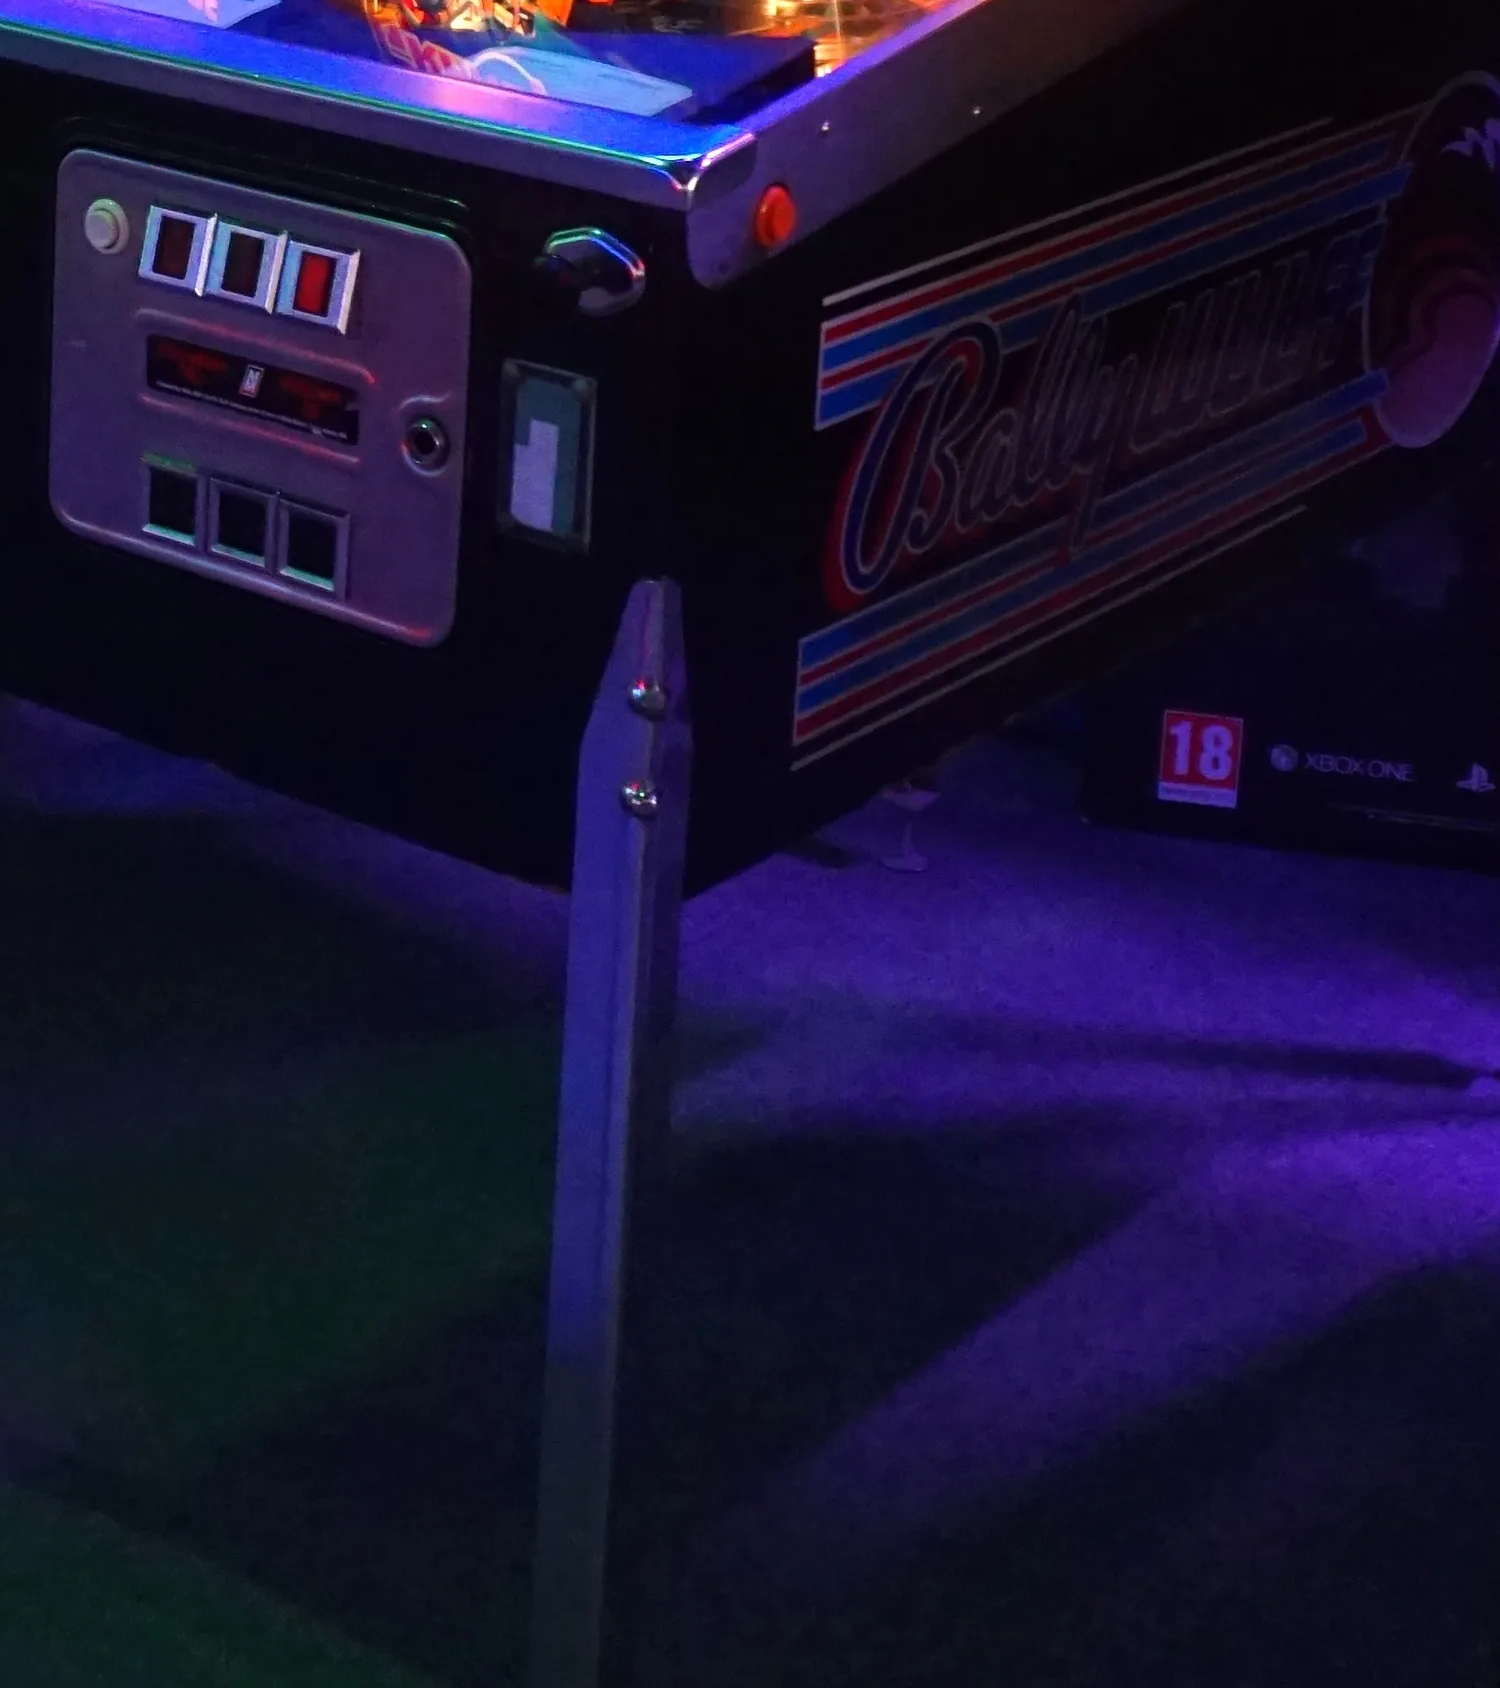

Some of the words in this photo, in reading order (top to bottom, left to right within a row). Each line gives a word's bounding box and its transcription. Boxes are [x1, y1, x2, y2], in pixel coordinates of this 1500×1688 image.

[1169, 721, 1234, 781] 18
[1303, 751, 1365, 775] XBOX
[1367, 758, 1416, 783] ONE
